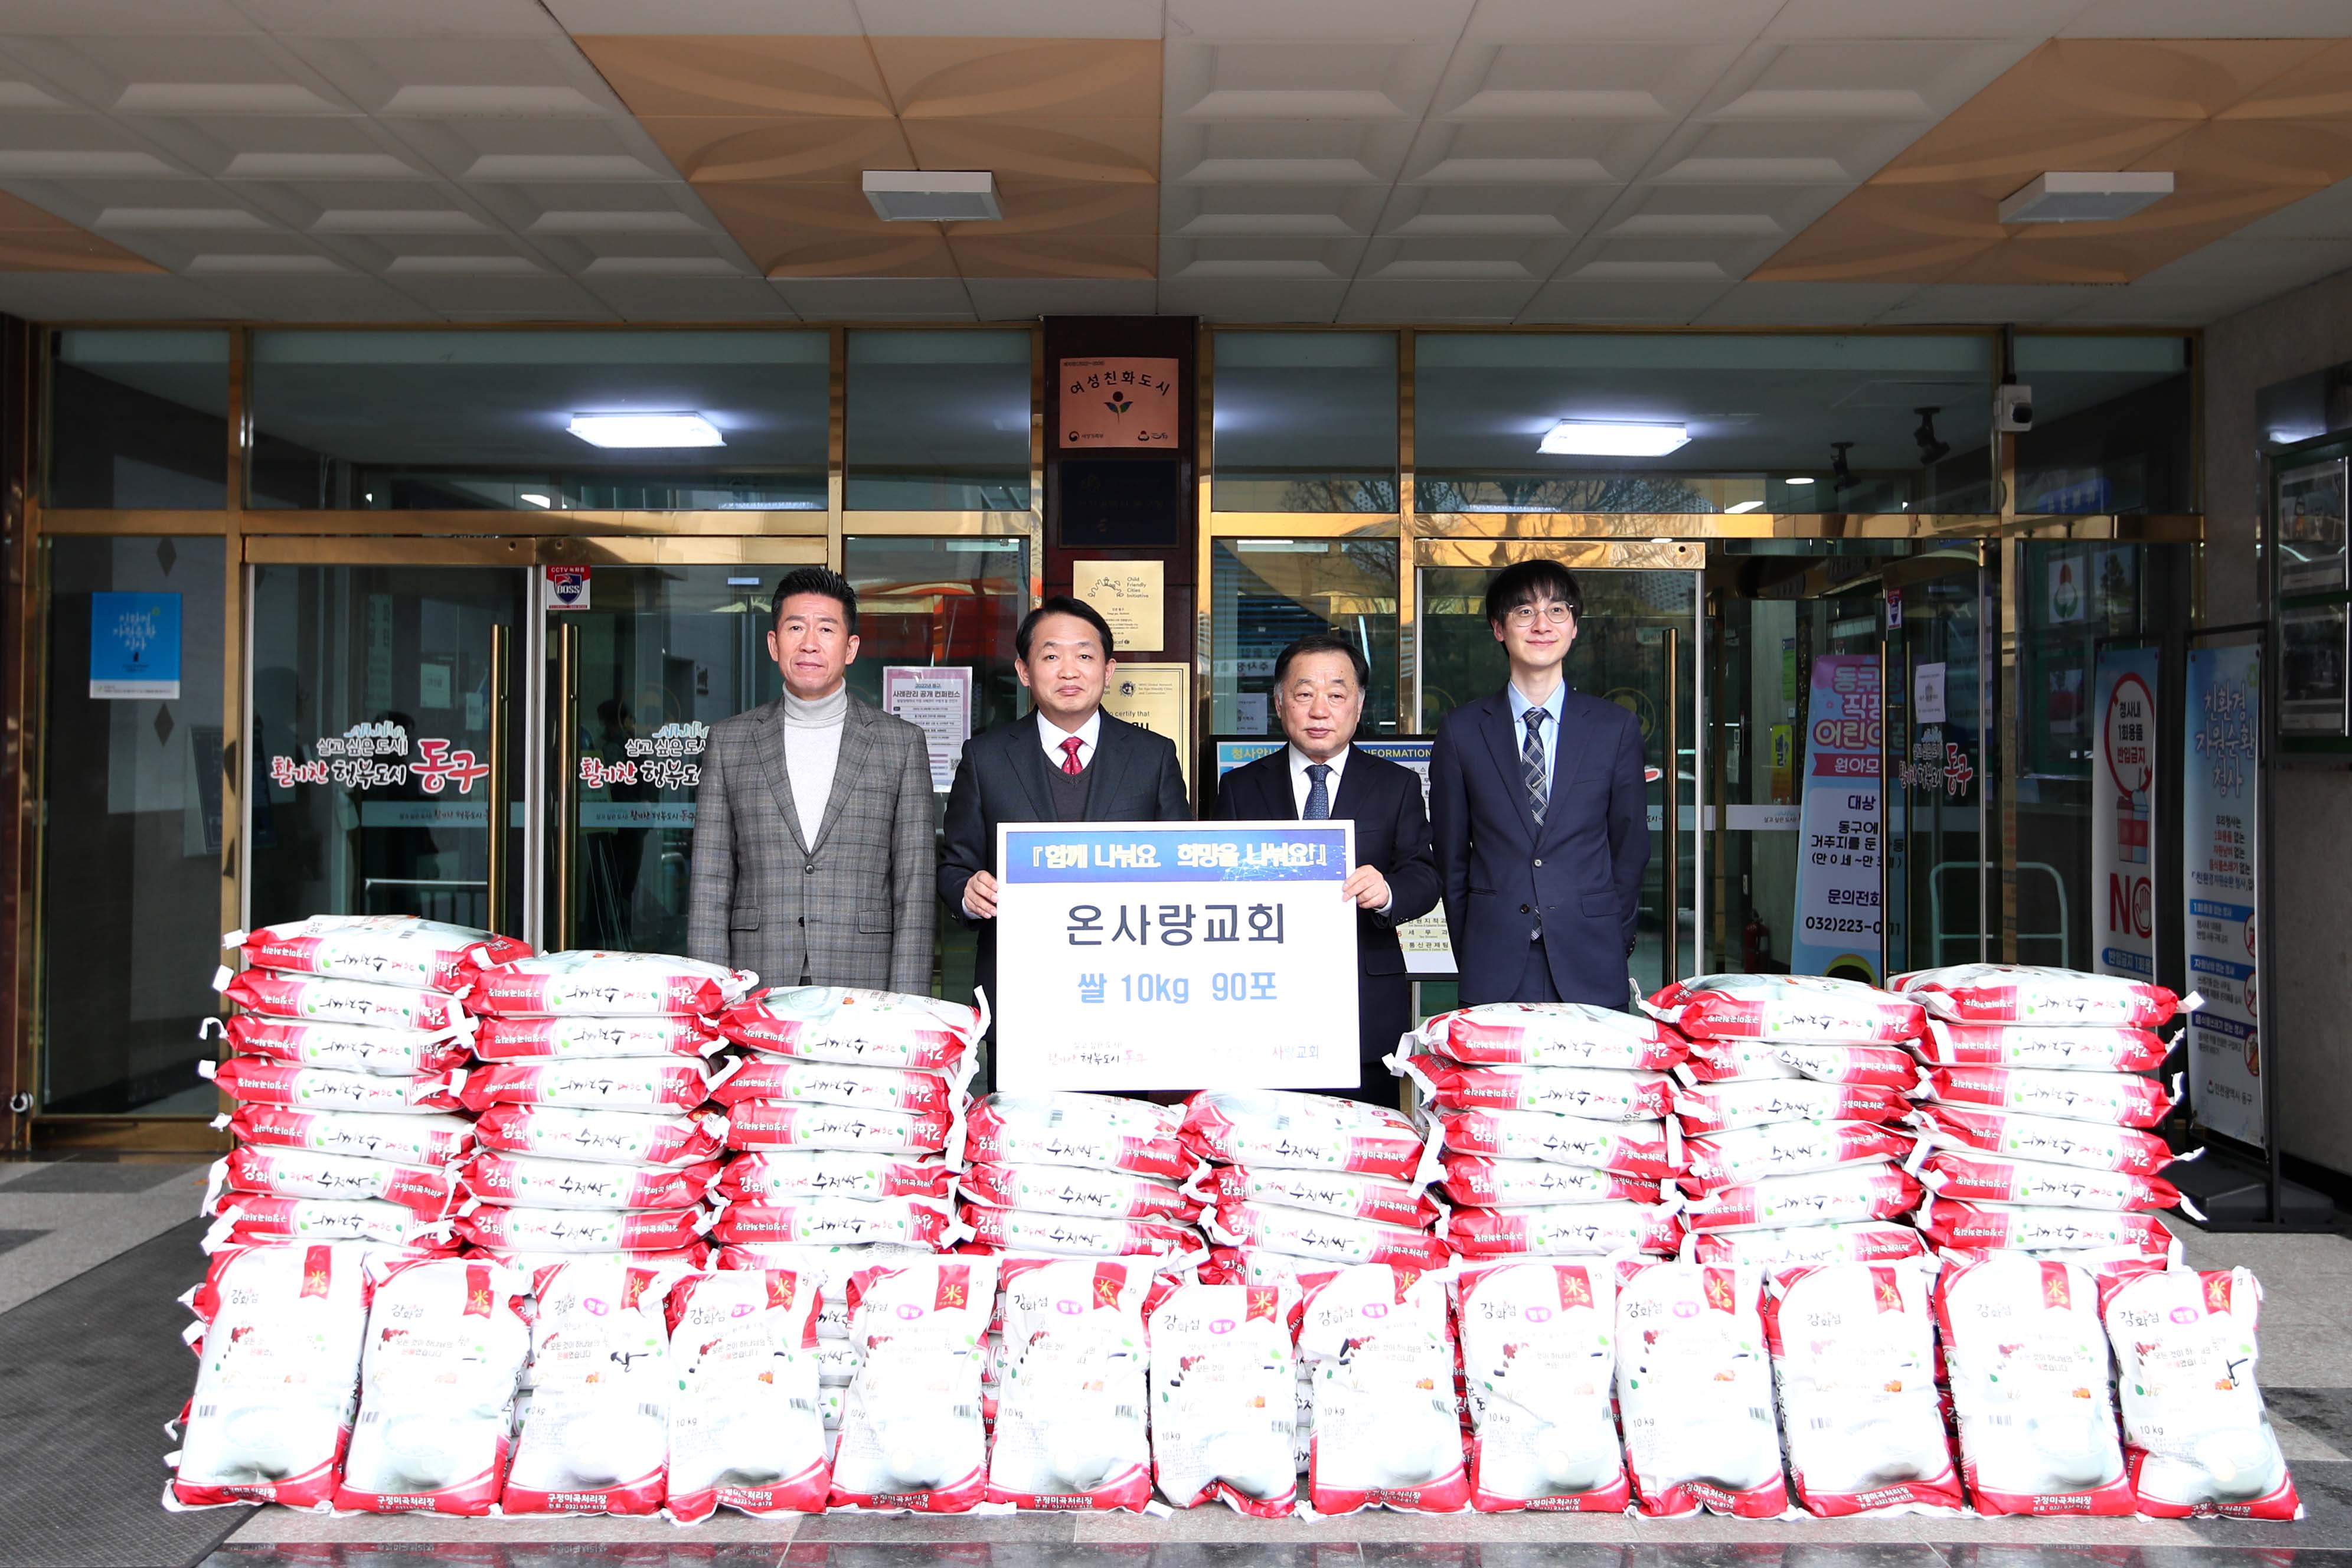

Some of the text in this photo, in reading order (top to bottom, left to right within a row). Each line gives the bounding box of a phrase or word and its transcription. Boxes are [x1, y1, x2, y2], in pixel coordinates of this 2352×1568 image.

[1070, 371, 1170, 396] 여성친화도시
[557, 585, 580, 594] BOSS
[2119, 701, 2141, 718] 청사내
[2203, 681, 2246, 721] 친환경
[2118, 724, 2143, 741] 1회용품
[2196, 717, 2256, 758] 자원순환
[655, 739, 683, 757] 싶은
[1360, 749, 1432, 757] NFORMATION
[2117, 746, 2145, 764] 반입금지
[271, 739, 489, 794] 활기찬 행복도시 동구
[579, 756, 703, 790] 활기찬 행복도
[1834, 757, 1879, 773] 원아모
[1943, 742, 1973, 796] 동구
[2214, 755, 2243, 796] 청사
[1848, 795, 1876, 811] 대상
[1838, 821, 1879, 834] 동구에
[1811, 835, 1876, 851] 거주지를 둔
[1177, 843, 1240, 868] 희망을
[1066, 903, 1285, 947] 온사랑교회
[1077, 972, 1278, 1004] 쌀 10kg 90포
[630, 1278, 644, 1297] 米
[773, 1279, 792, 1299] 米
[1097, 1279, 1115, 1297] 米
[1564, 1277, 1583, 1296] 米
[2206, 1280, 2226, 1301] 米
[473, 1289, 490, 1305] 米
[377, 1495, 435, 1506] 구정미곡처리장
[548, 1494, 607, 1504] 구정미곡처리장
[1034, 1496, 1093, 1505] 구정미곡처리장
[1525, 1499, 1580, 1508] 구정미곡처리장
